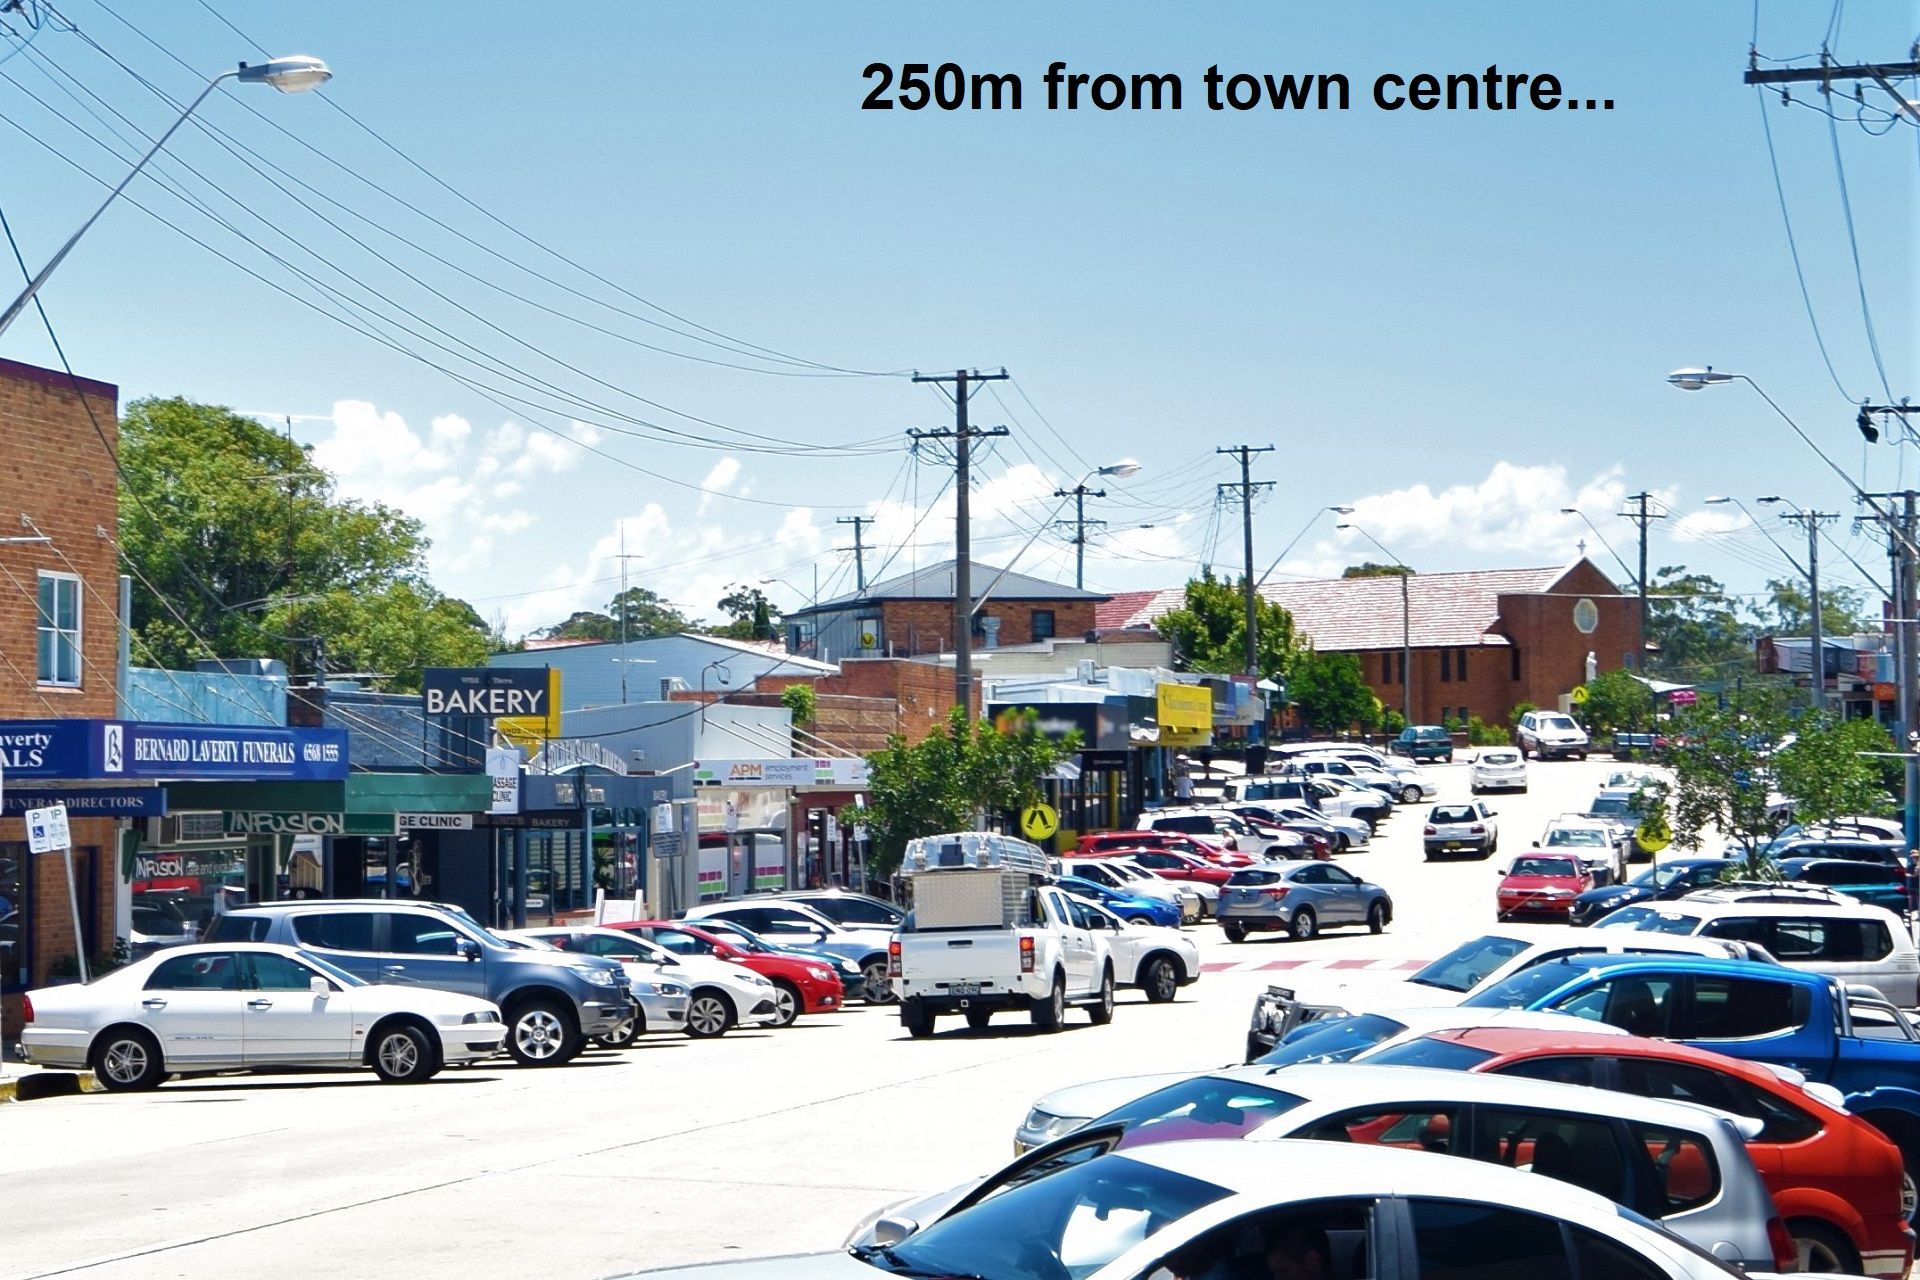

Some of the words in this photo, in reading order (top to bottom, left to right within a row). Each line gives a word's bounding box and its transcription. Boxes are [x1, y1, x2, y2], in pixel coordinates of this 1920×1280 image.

[427, 689, 544, 714] BAKERY
[134, 738, 190, 761] BERNARD
[191, 740, 240, 763] LAVERTY
[242, 741, 296, 764] FUNERALS
[729, 763, 763, 776] APM
[765, 763, 808, 774] employment
[765, 773, 793, 781] services
[66, 796, 144, 809] DIRECTORS
[32, 811, 41, 823] P
[230, 811, 345, 834] INFUSION
[399, 816, 416, 827] GE
[419, 816, 462, 827] CLINIC
[531, 817, 570, 828] BAKERY
